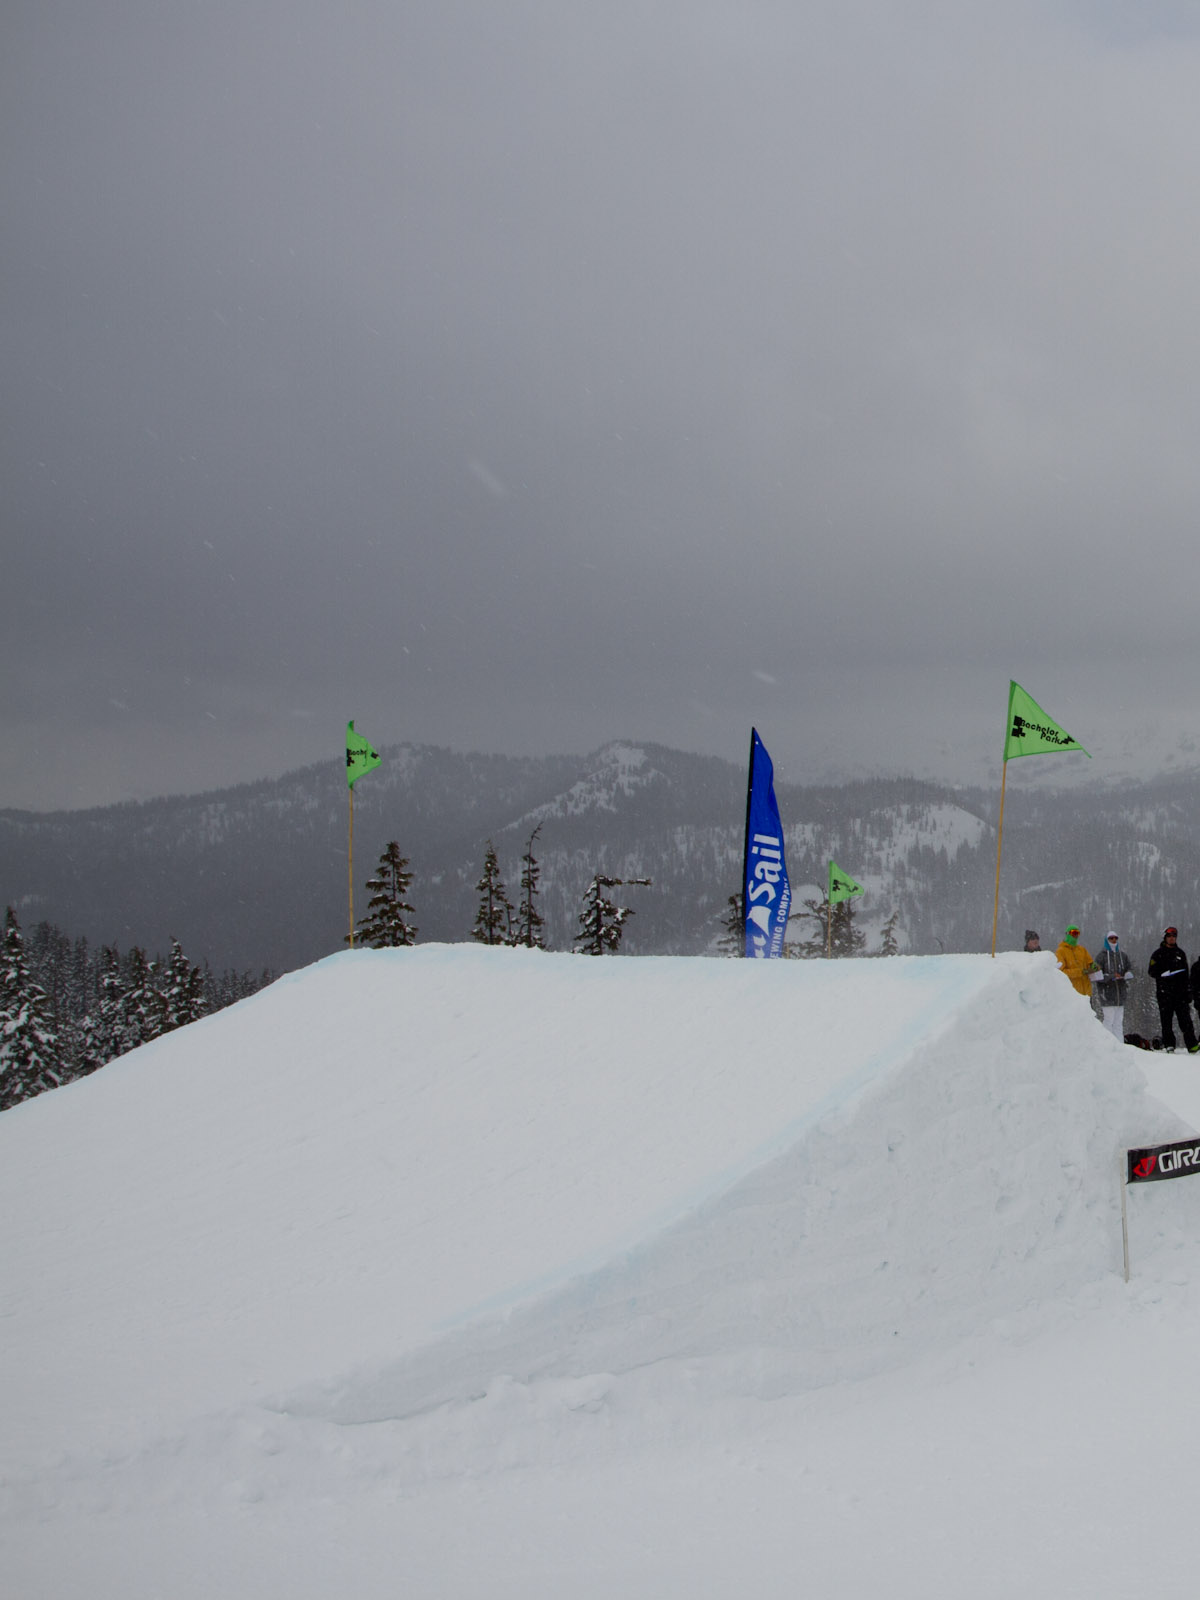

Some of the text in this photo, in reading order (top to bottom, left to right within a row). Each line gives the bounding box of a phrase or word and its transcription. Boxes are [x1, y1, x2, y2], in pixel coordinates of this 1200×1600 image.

[1020, 719, 1059, 737] Bachelor
[1040, 731, 1062, 745] Park
[748, 833, 782, 905] Sail
